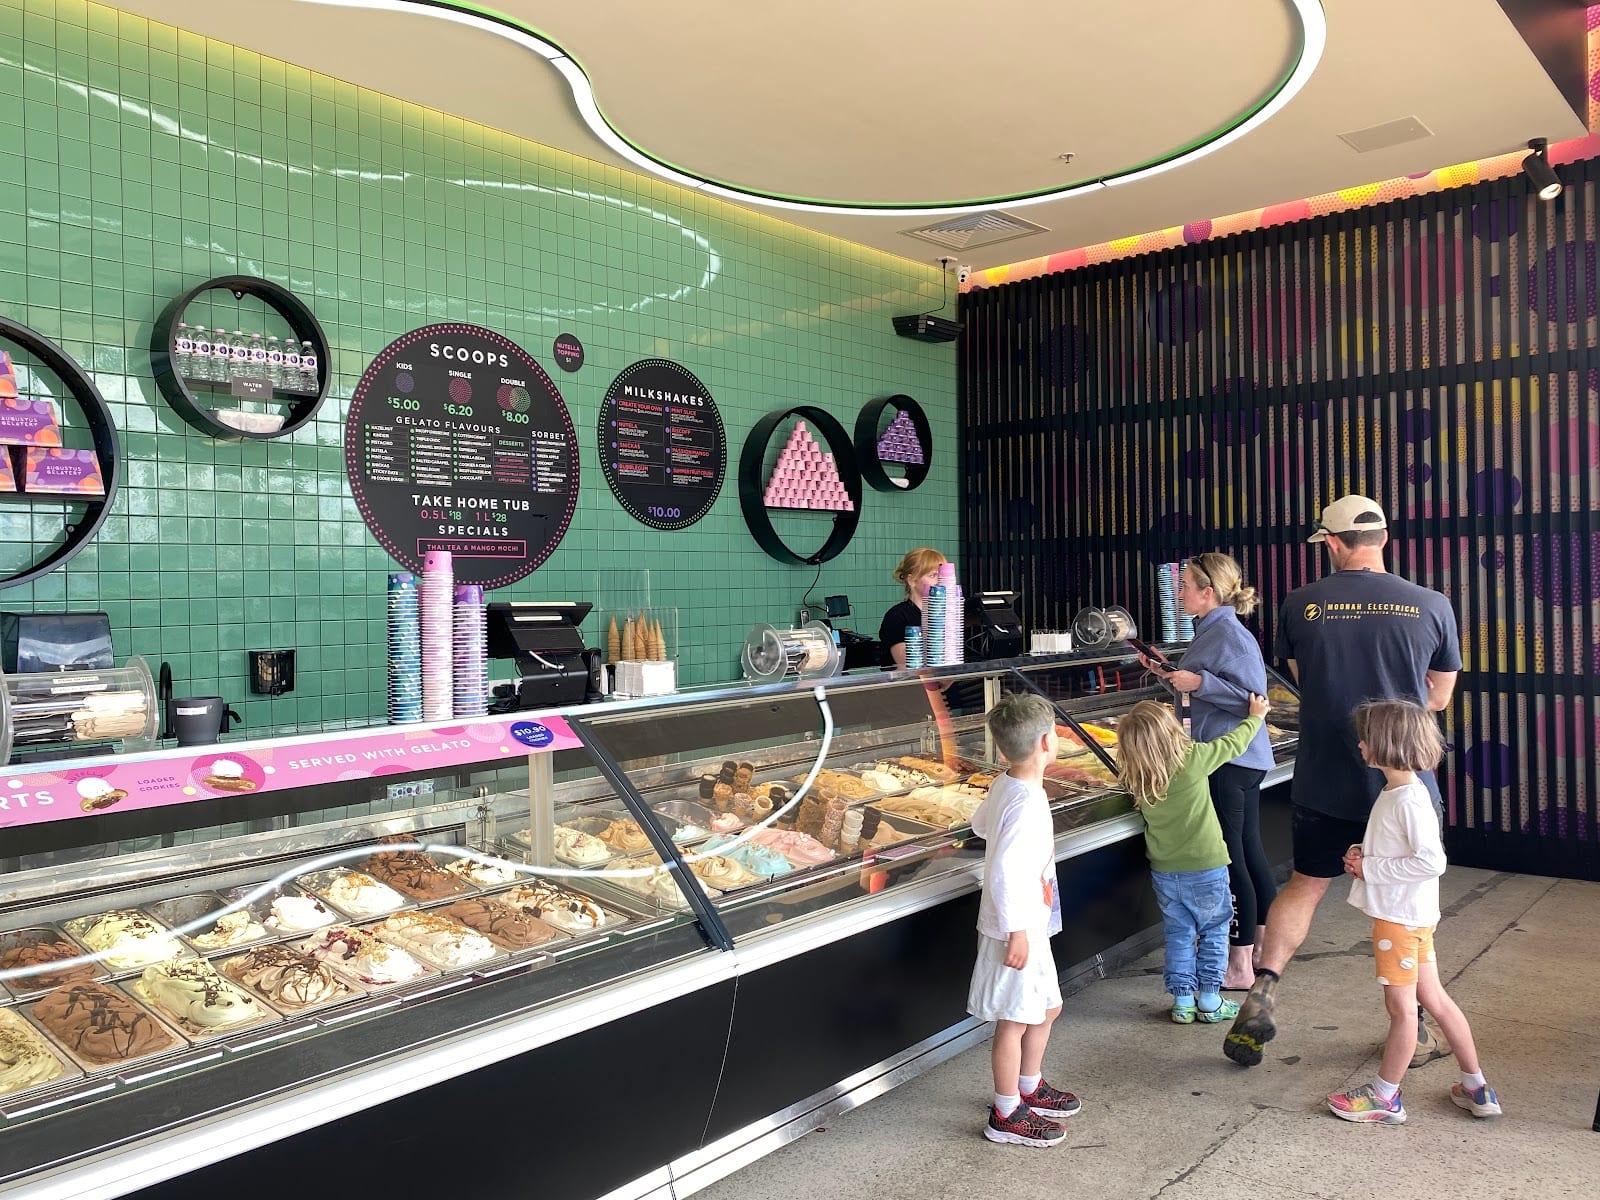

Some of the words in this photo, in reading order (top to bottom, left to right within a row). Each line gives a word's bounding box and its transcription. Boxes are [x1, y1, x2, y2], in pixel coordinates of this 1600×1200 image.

[557, 343, 580, 351] NUTELLA
[430, 343, 509, 368] SCOOPS
[557, 349, 580, 358] TOPPING
[396, 362, 413, 371] KIDS
[448, 370, 472, 379] SINGLE
[500, 378, 526, 387] DOUBLE
[624, 385, 704, 407] MILKSHAKES
[387, 397, 420, 411] $5.00
[443, 403, 473, 417] $6.20
[501, 410, 529, 424] $8.00
[396, 416, 440, 428] GELATO
[445, 421, 501, 434] FLAVOURS
[531, 431, 565, 440] SORBET
[411, 494, 452, 508] TAKE
[457, 497, 498, 510] HOME
[503, 500, 530, 511] TUB
[448, 510, 462, 520] $18
[492, 512, 507, 523] $28
[648, 506, 680, 518] $10.00
[438, 525, 508, 536] SPECIALS
[1327, 603, 1362, 611] MOONAH
[1367, 603, 1420, 614] ELECTRICAL
[514, 726, 546, 736] $10.90
[288, 754, 357, 770] SERVED
[362, 747, 407, 761] WITH
[410, 739, 471, 754] GELATO
[137, 776, 175, 785] LOADED
[139, 782, 180, 792] COOKIES
